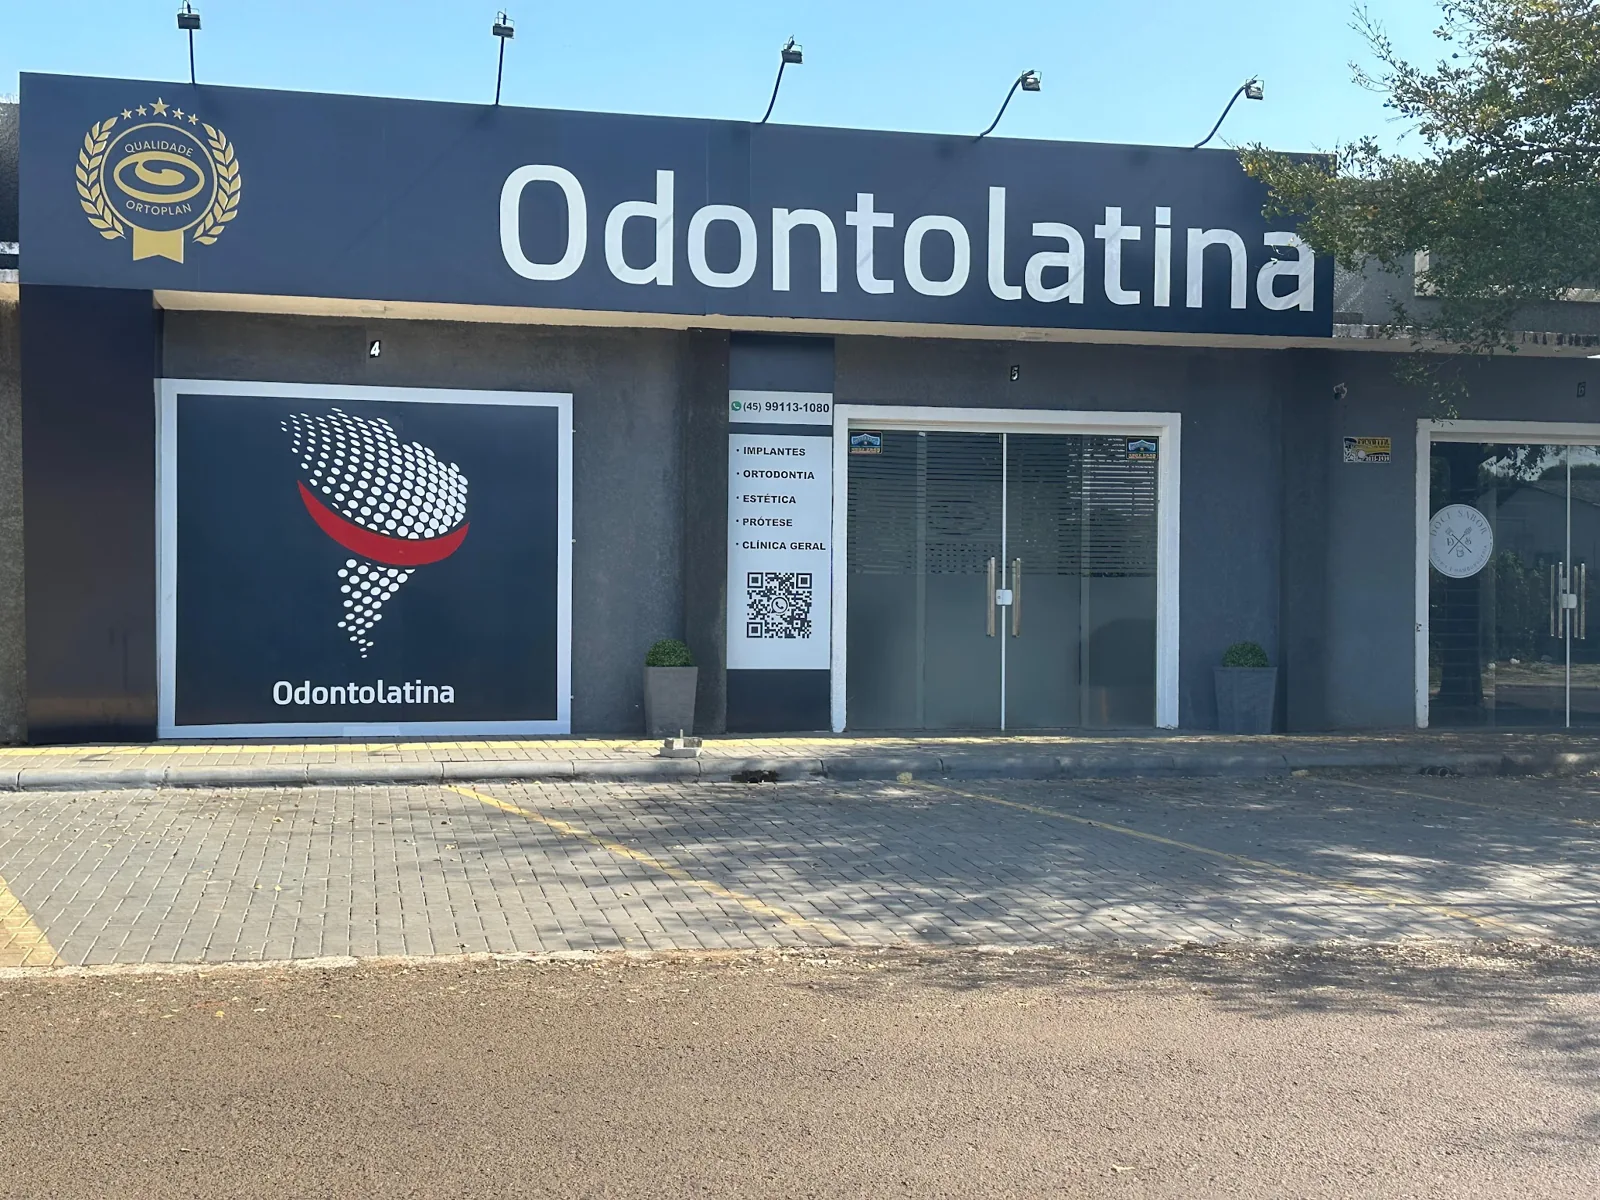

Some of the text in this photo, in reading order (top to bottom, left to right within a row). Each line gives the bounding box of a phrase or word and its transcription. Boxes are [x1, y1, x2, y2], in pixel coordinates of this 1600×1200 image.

[125, 140, 194, 157] QUALIDADE
[126, 200, 192, 215] ORTOPLAN
[500, 164, 1315, 312] Odontolatina
[370, 341, 380, 356] 4
[1011, 366, 1019, 380] 5
[743, 401, 830, 413] (45) 99113-1080
[743, 447, 806, 456] IMPLANTES
[743, 470, 815, 480] ORTODONTIA
[743, 493, 797, 504] ESTÉTICA
[742, 516, 793, 527] PRÓTESE
[742, 541, 826, 551] CLÍNICA GERAL
[273, 679, 455, 705] Odontolatina
